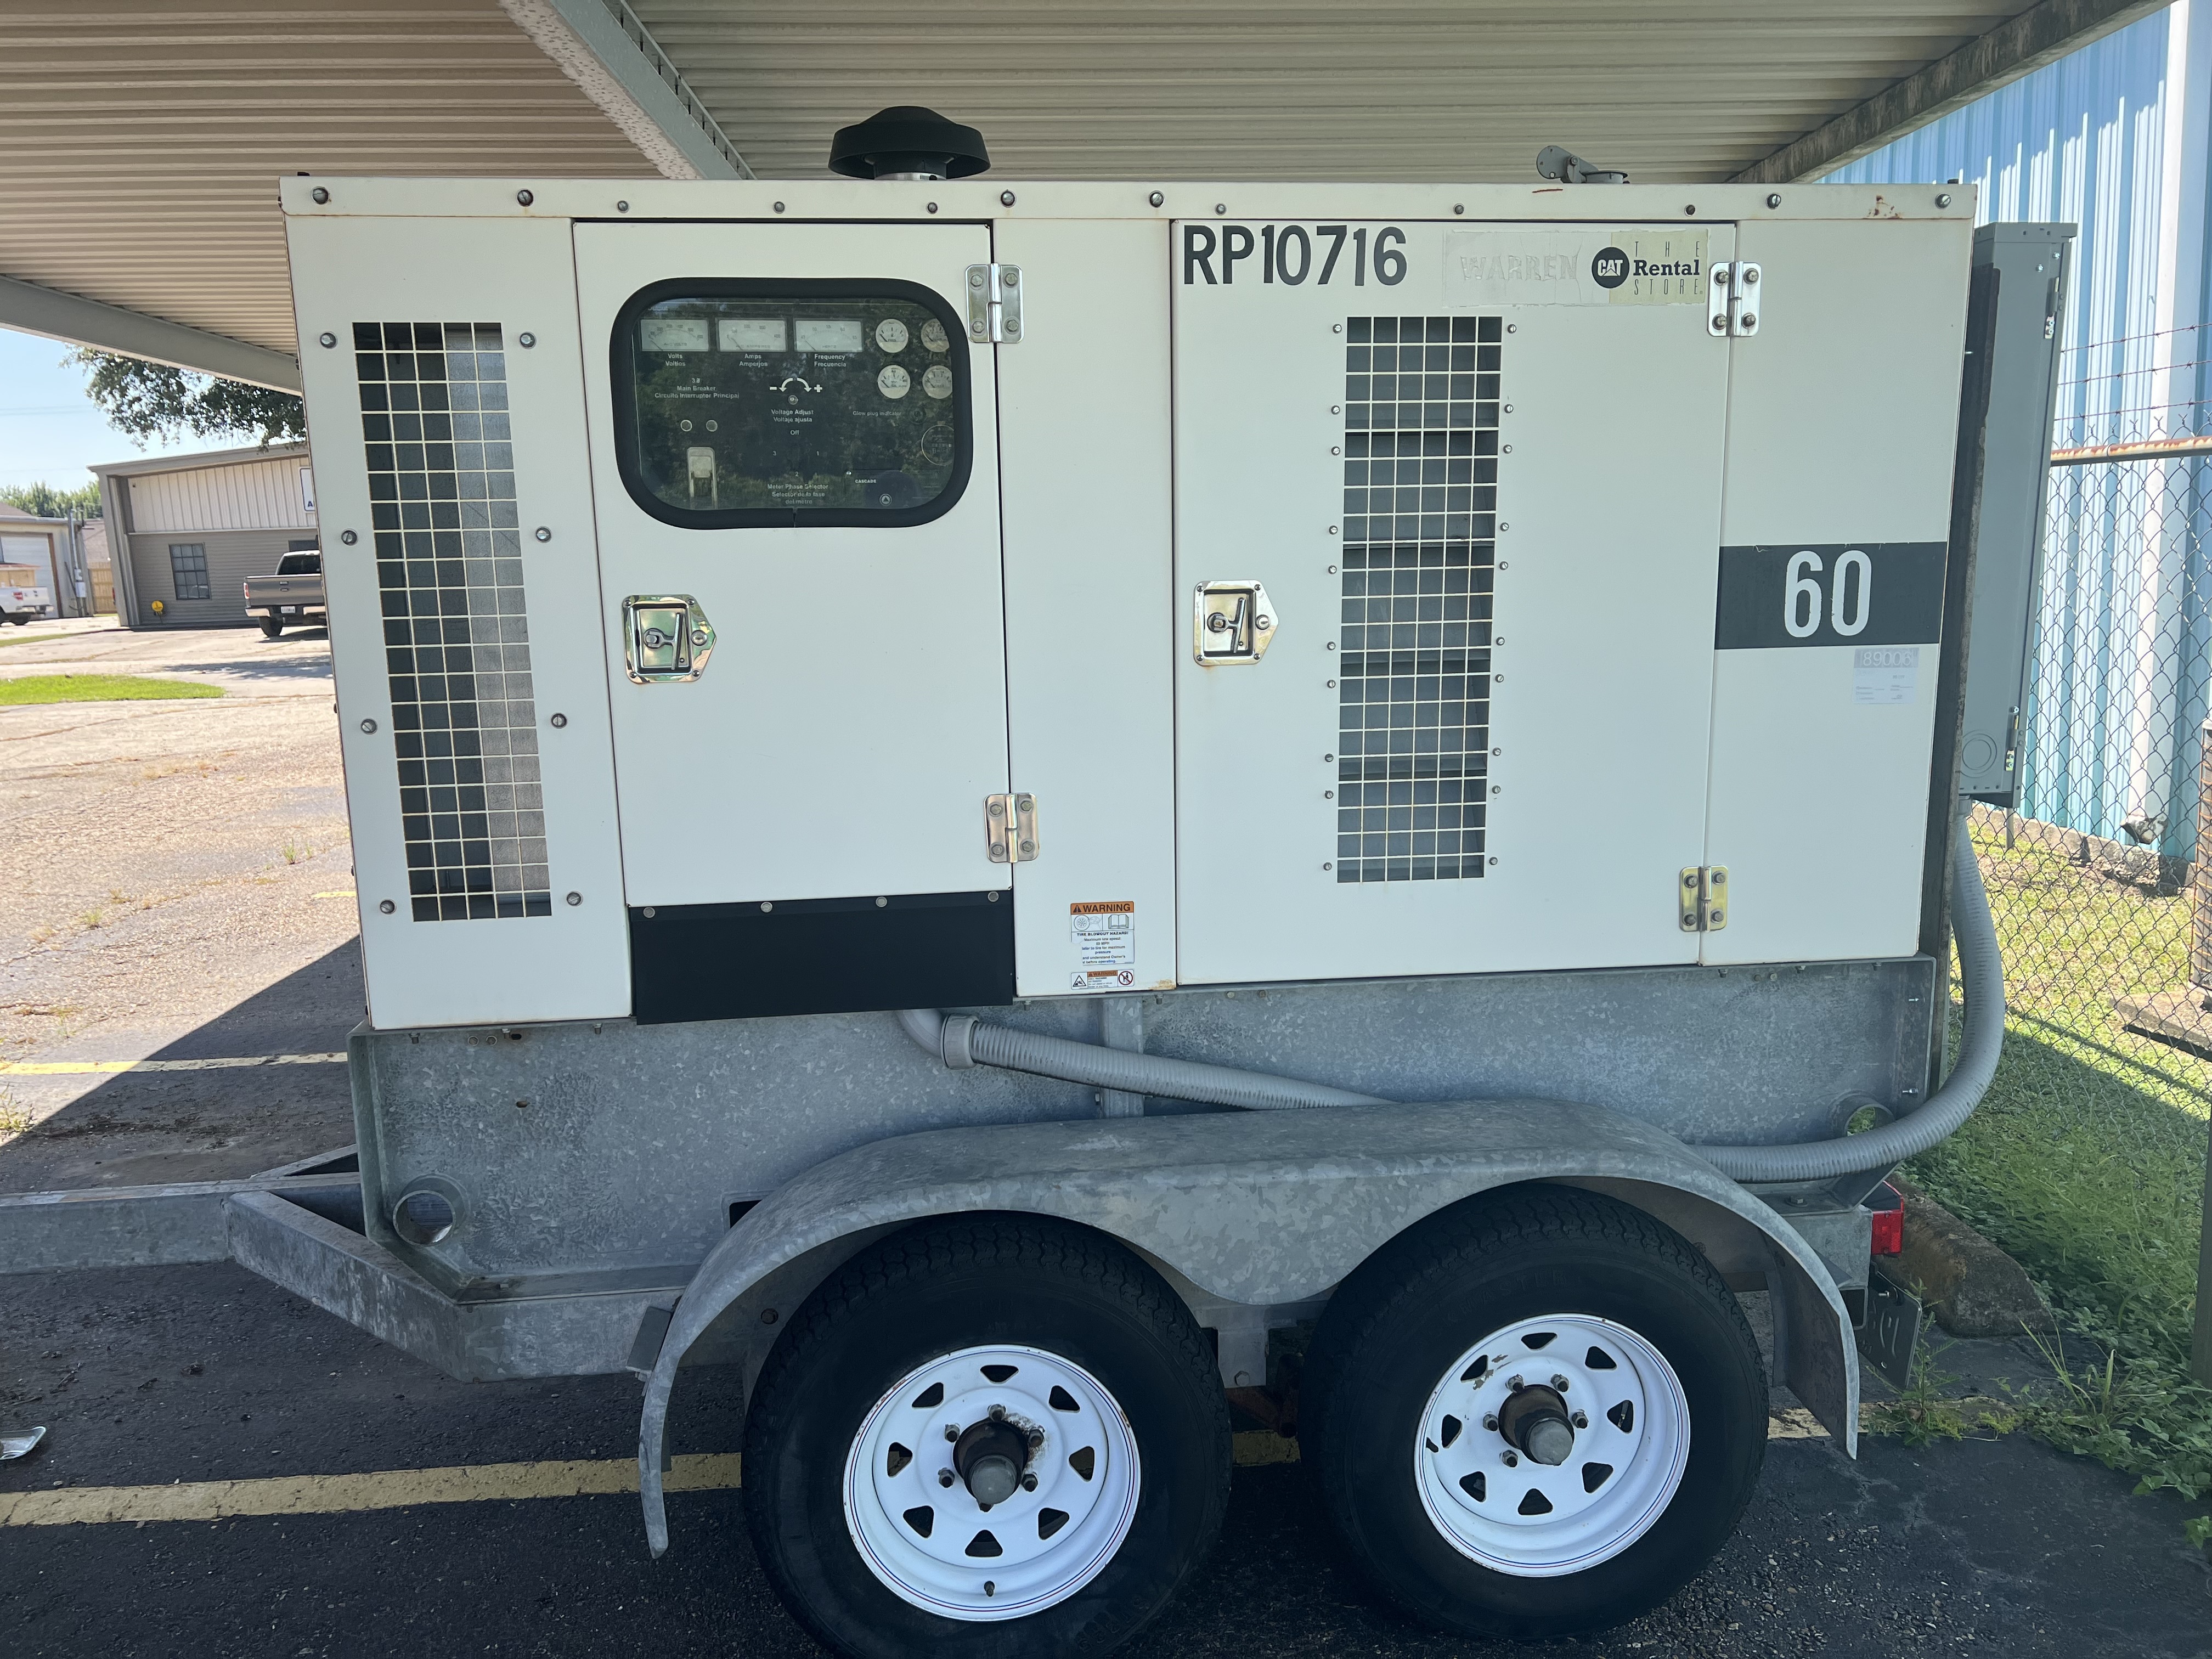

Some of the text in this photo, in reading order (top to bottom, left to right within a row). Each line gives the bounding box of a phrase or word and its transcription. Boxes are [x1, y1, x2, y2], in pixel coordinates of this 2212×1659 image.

[1184, 224, 1407, 286] RP10716
[1635, 241, 1700, 257] THE
[1460, 254, 1700, 281] WARREN CAT Rental
[1784, 550, 1872, 637] 60
[1083, 903, 1131, 913] WARNING
